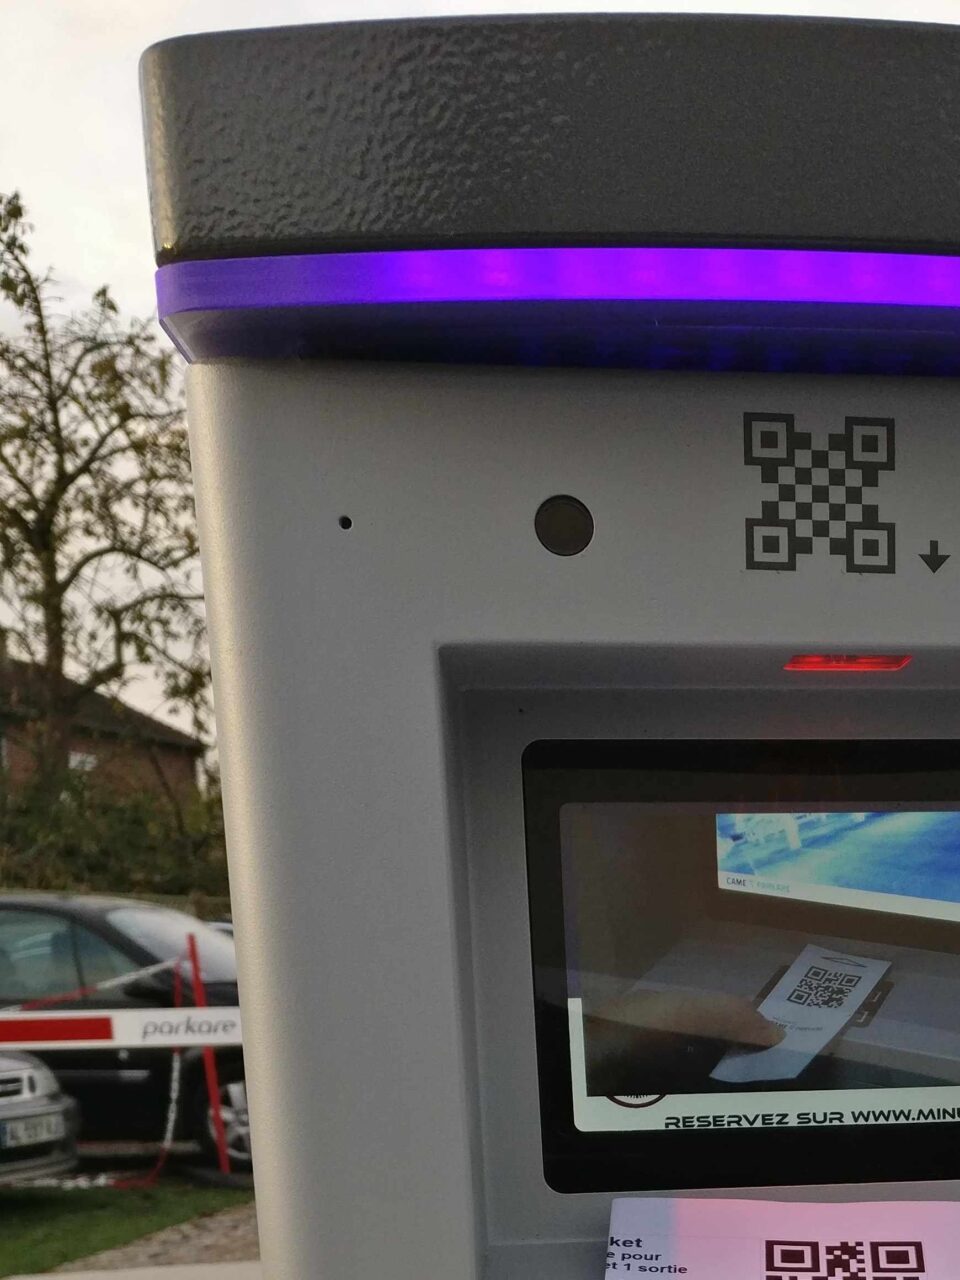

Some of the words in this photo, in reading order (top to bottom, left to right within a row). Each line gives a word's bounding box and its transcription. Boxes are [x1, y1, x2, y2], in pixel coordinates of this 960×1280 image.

[142, 1016, 237, 1038] parkare
[664, 1113, 790, 1129] RESERVEZ
[797, 1111, 845, 1125] SUR
[609, 1236, 643, 1248] ket
[621, 1253, 662, 1261] pour
[624, 1263, 631, 1271] 1
[638, 1265, 688, 1274] sortie
